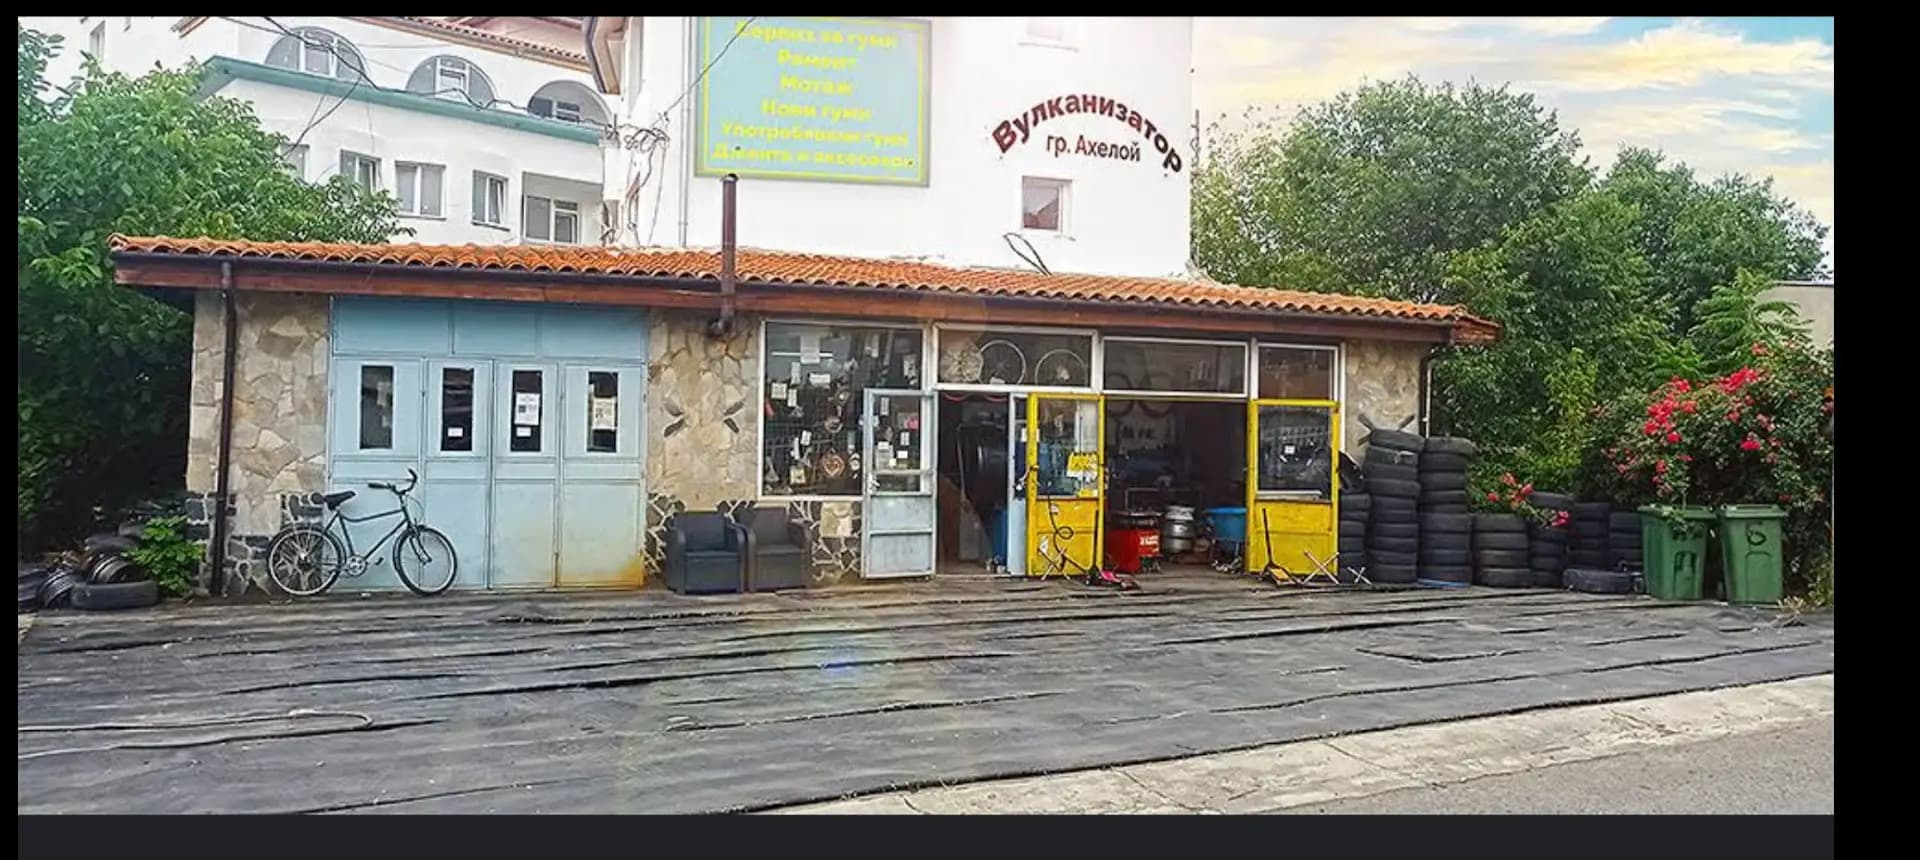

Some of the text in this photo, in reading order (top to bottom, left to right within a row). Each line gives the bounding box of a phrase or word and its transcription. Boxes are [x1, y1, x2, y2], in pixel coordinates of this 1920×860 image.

[992, 94, 1182, 173] Вулканизатор
[1046, 135, 1141, 162] гр. Ахелой
